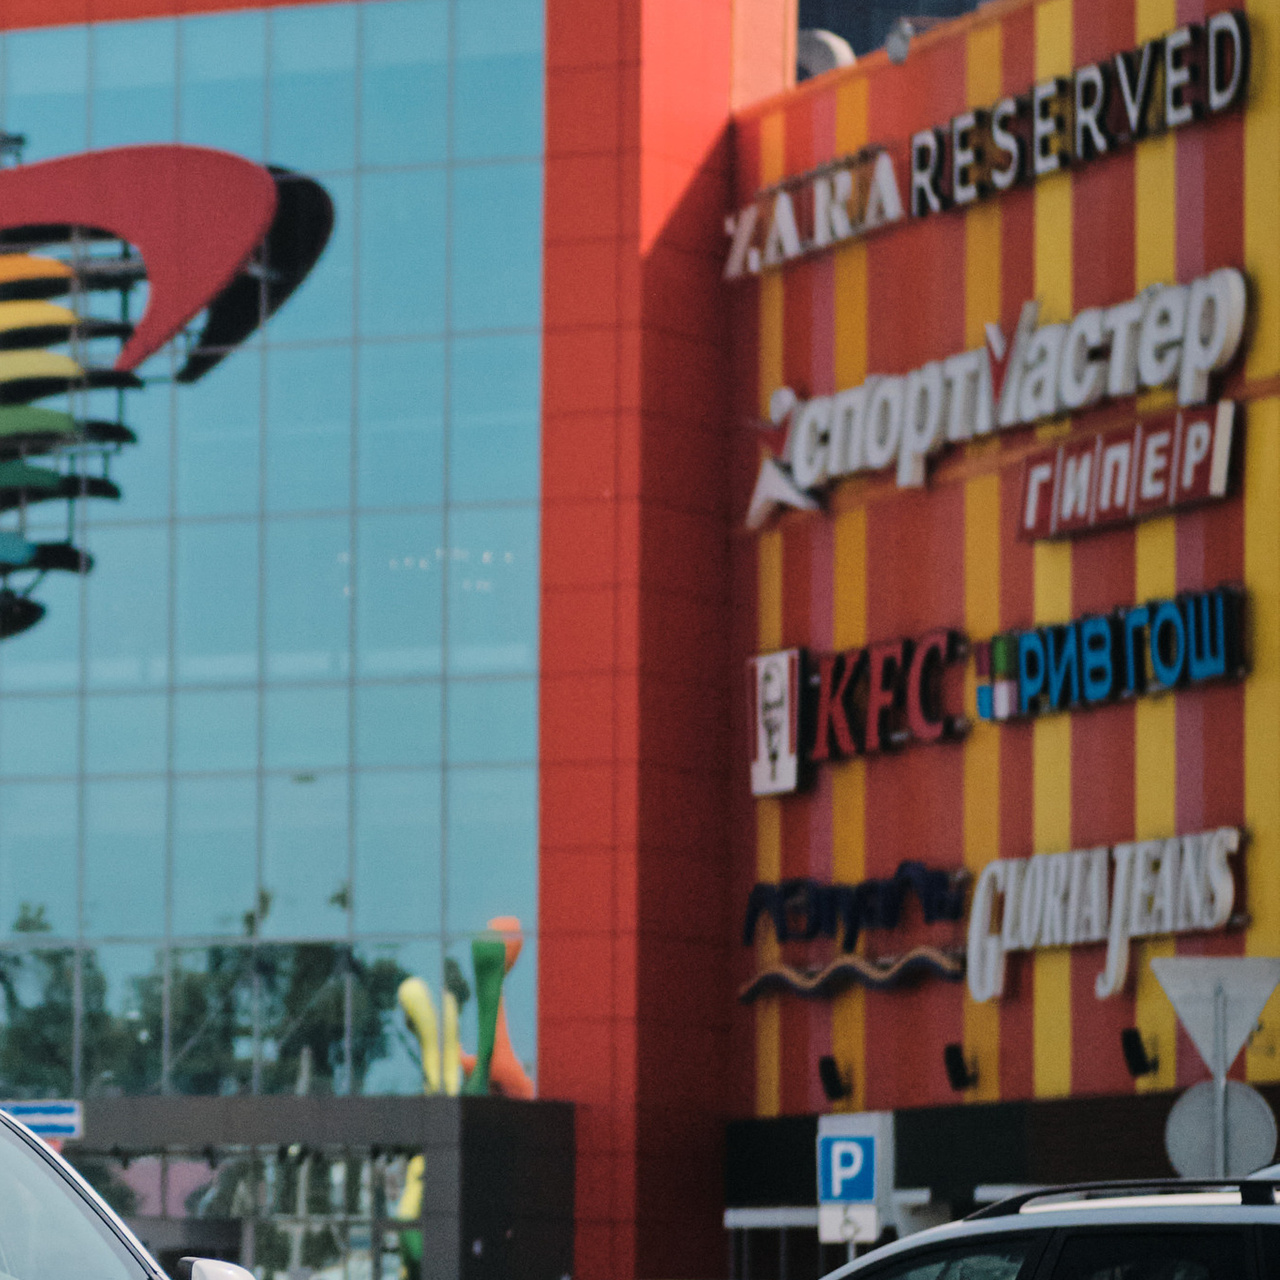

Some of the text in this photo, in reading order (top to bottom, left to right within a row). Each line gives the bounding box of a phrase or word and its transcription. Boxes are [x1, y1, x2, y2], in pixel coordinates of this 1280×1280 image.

[911, 12, 1244, 217] RESERVED
[725, 150, 904, 279] ZARA
[1024, 421, 1211, 529] ГИПЕР
[813, 632, 949, 760] KFC
[1021, 591, 1226, 713] РИВ ГОШ
[1095, 827, 1240, 999] JEANS
